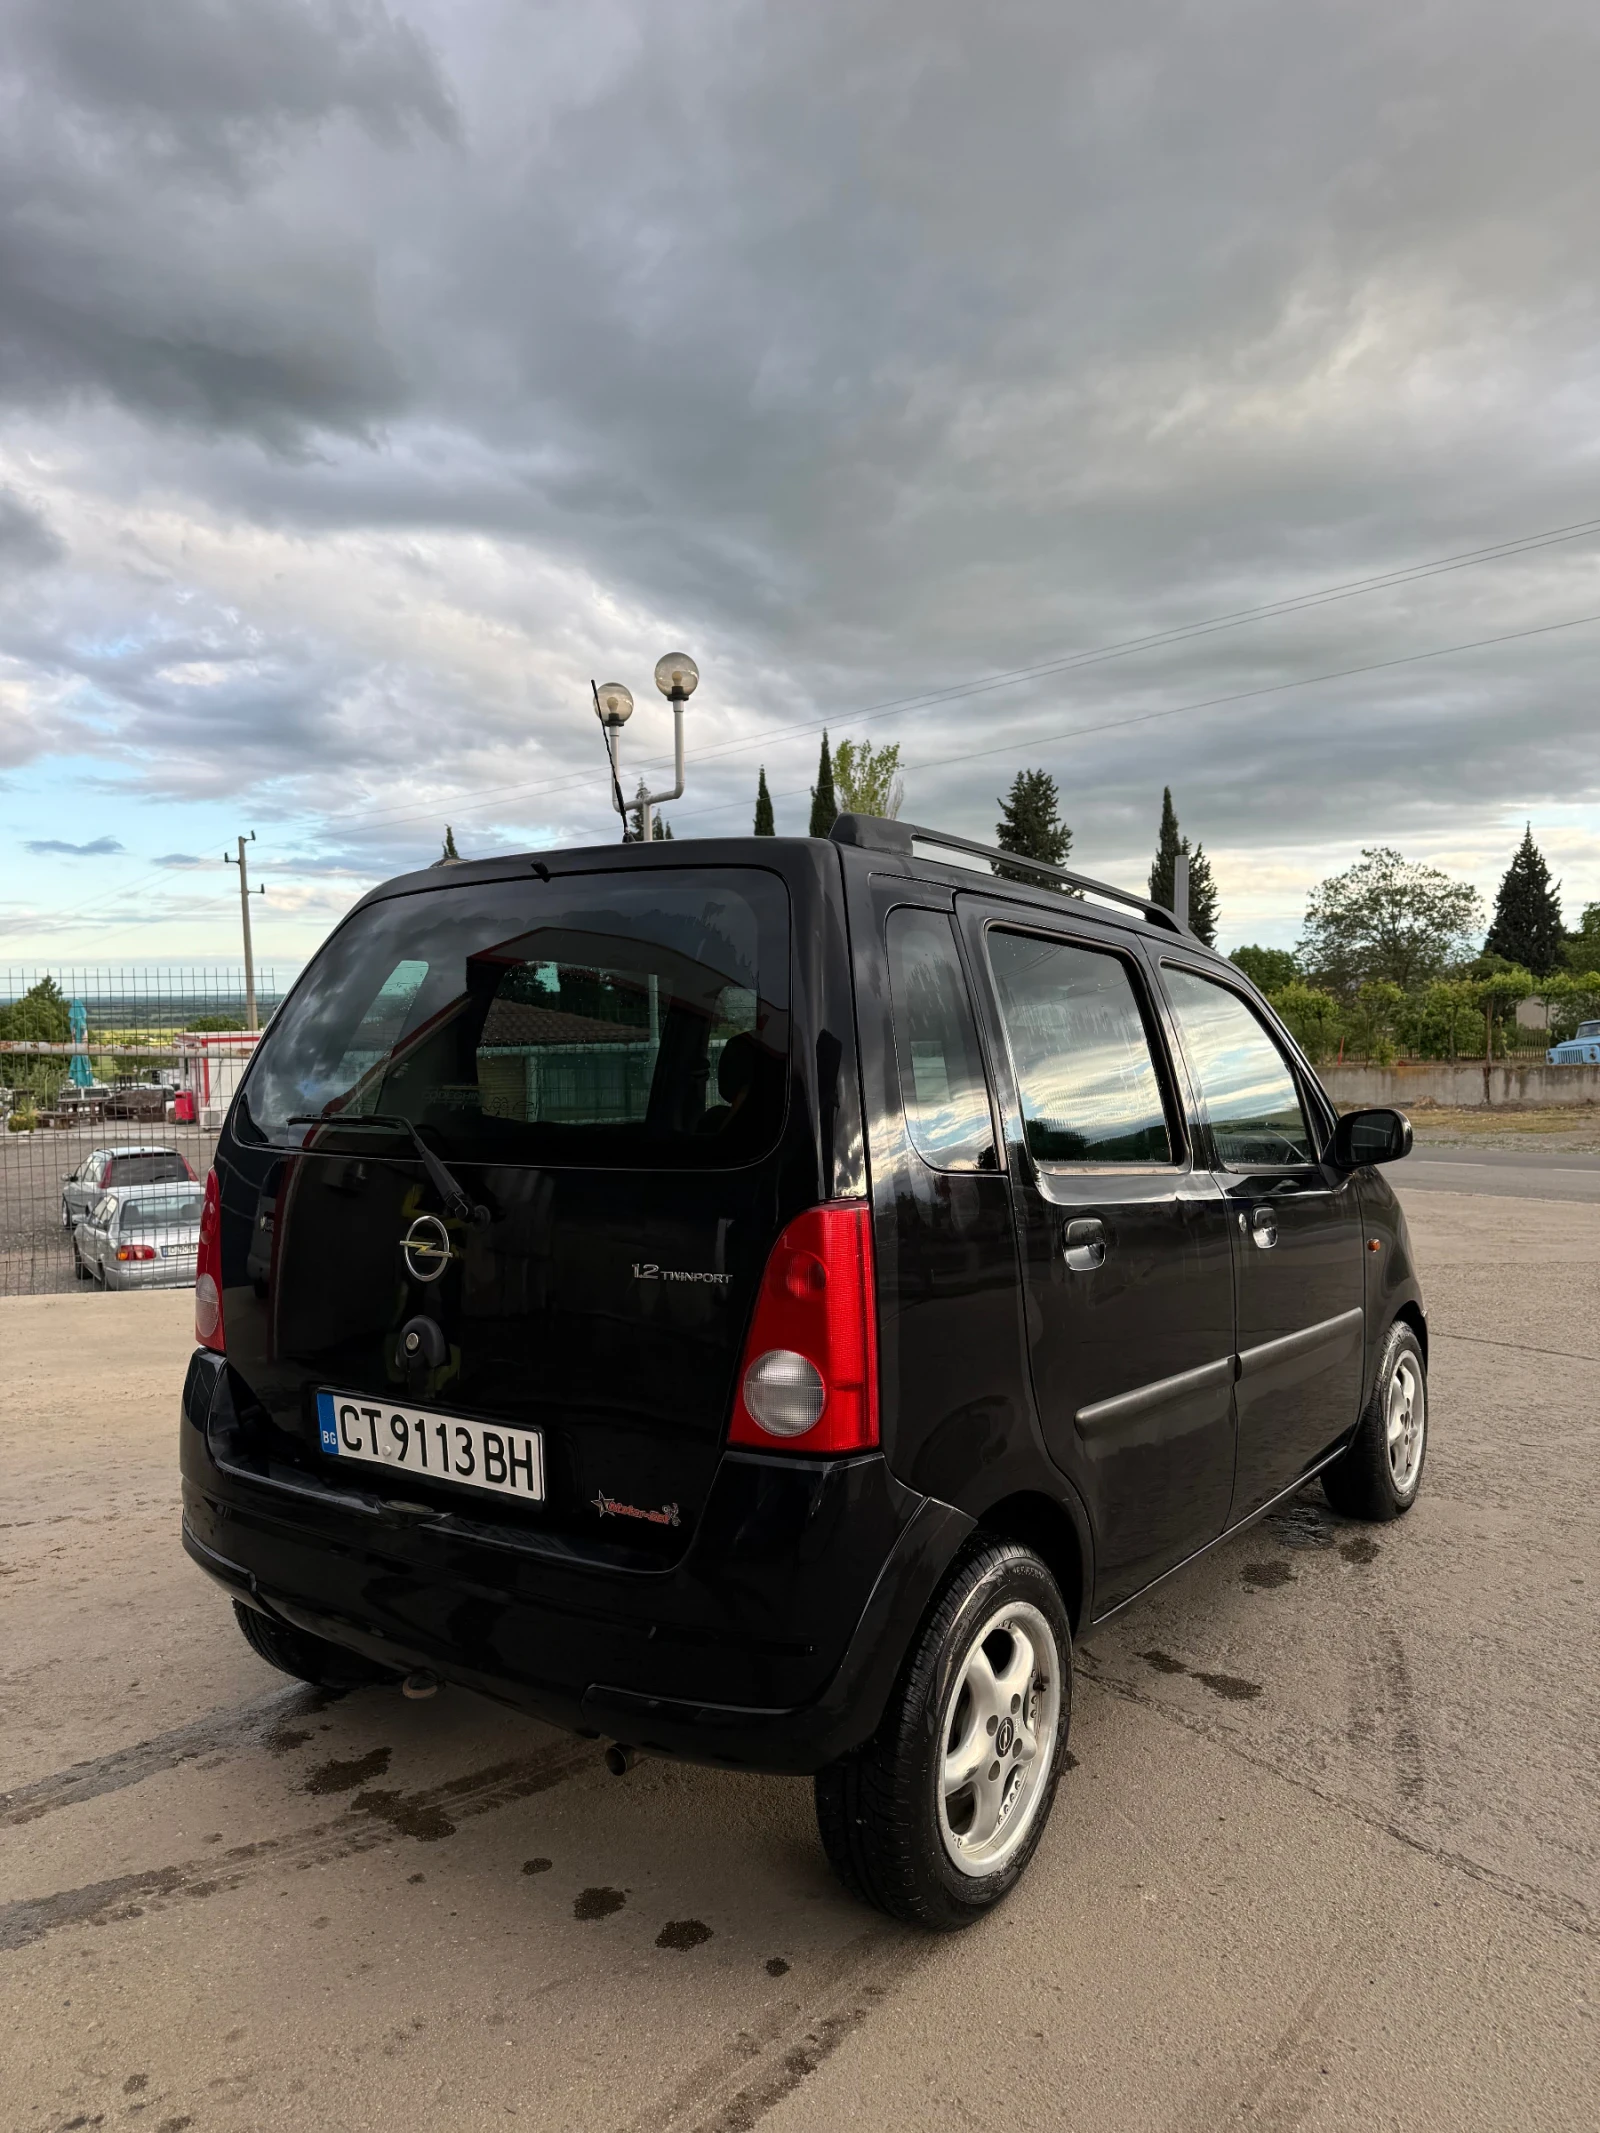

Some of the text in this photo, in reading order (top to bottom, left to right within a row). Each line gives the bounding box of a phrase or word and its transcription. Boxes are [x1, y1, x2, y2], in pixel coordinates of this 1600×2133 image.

[660, 1270, 734, 1284] TWINPORT
[322, 1430, 337, 1445] BG
[339, 1404, 534, 1491] CT 9113 BH
